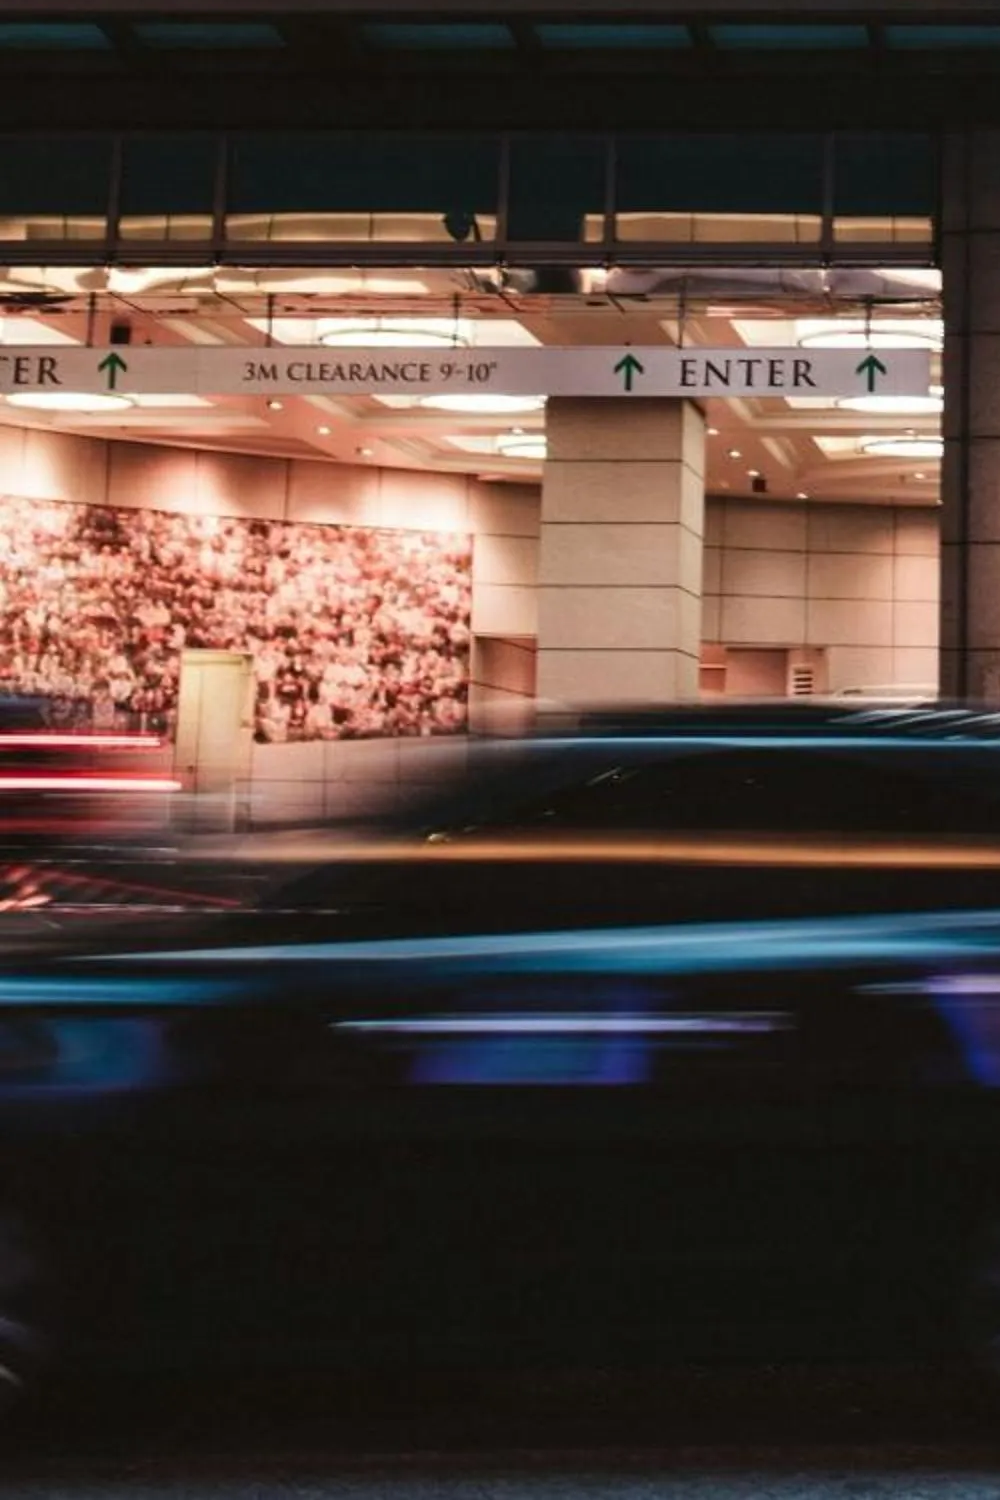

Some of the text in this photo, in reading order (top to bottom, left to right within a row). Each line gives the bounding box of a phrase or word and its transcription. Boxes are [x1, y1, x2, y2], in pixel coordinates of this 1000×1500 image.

[243, 362, 278, 382] 3M
[286, 362, 431, 382] CLEARANCE
[679, 358, 817, 387] ENTER
